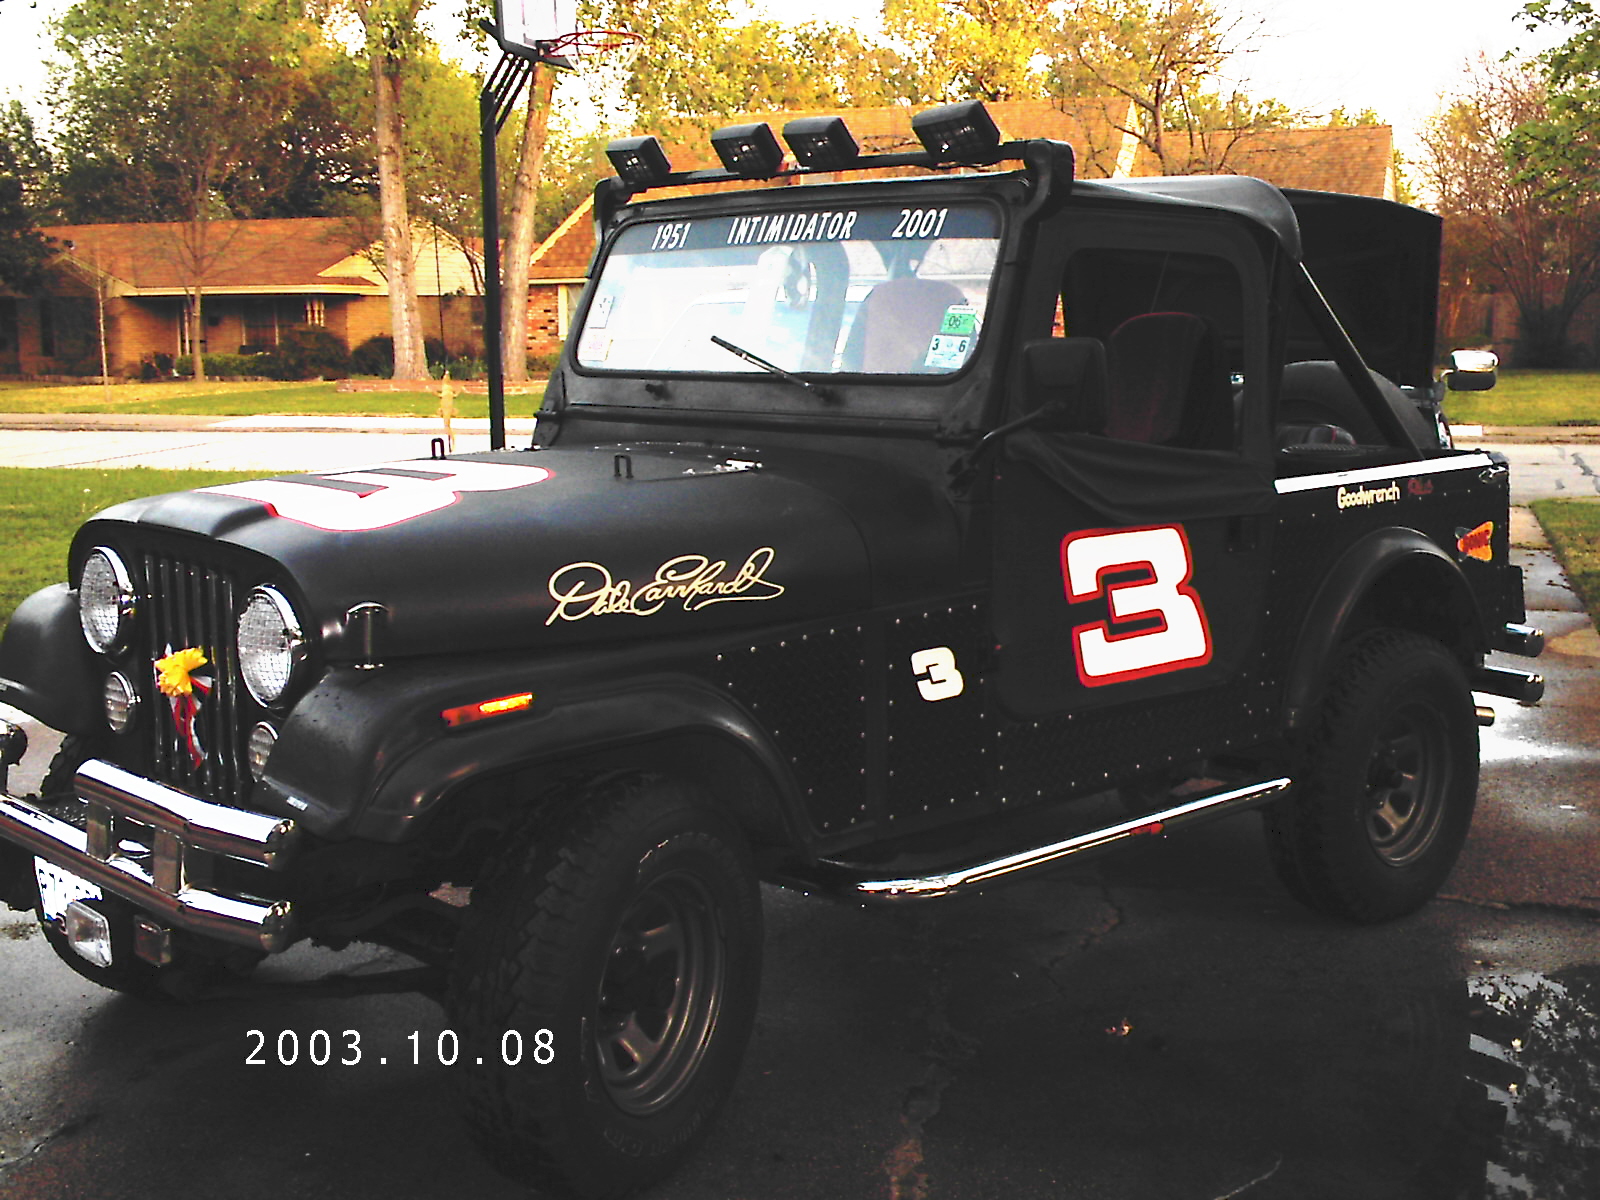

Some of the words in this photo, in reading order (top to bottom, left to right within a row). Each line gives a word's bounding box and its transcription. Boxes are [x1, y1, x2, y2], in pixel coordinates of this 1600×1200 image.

[651, 222, 692, 251] 1951
[726, 211, 857, 245] INTIMIDATOR
[891, 208, 948, 238] 2001
[932, 338, 940, 351] 3
[958, 340, 967, 353] 6
[1337, 480, 1400, 509] Goodwrench
[545, 561, 637, 626] Dale
[1060, 523, 1213, 688] 3
[910, 646, 964, 702] 3
